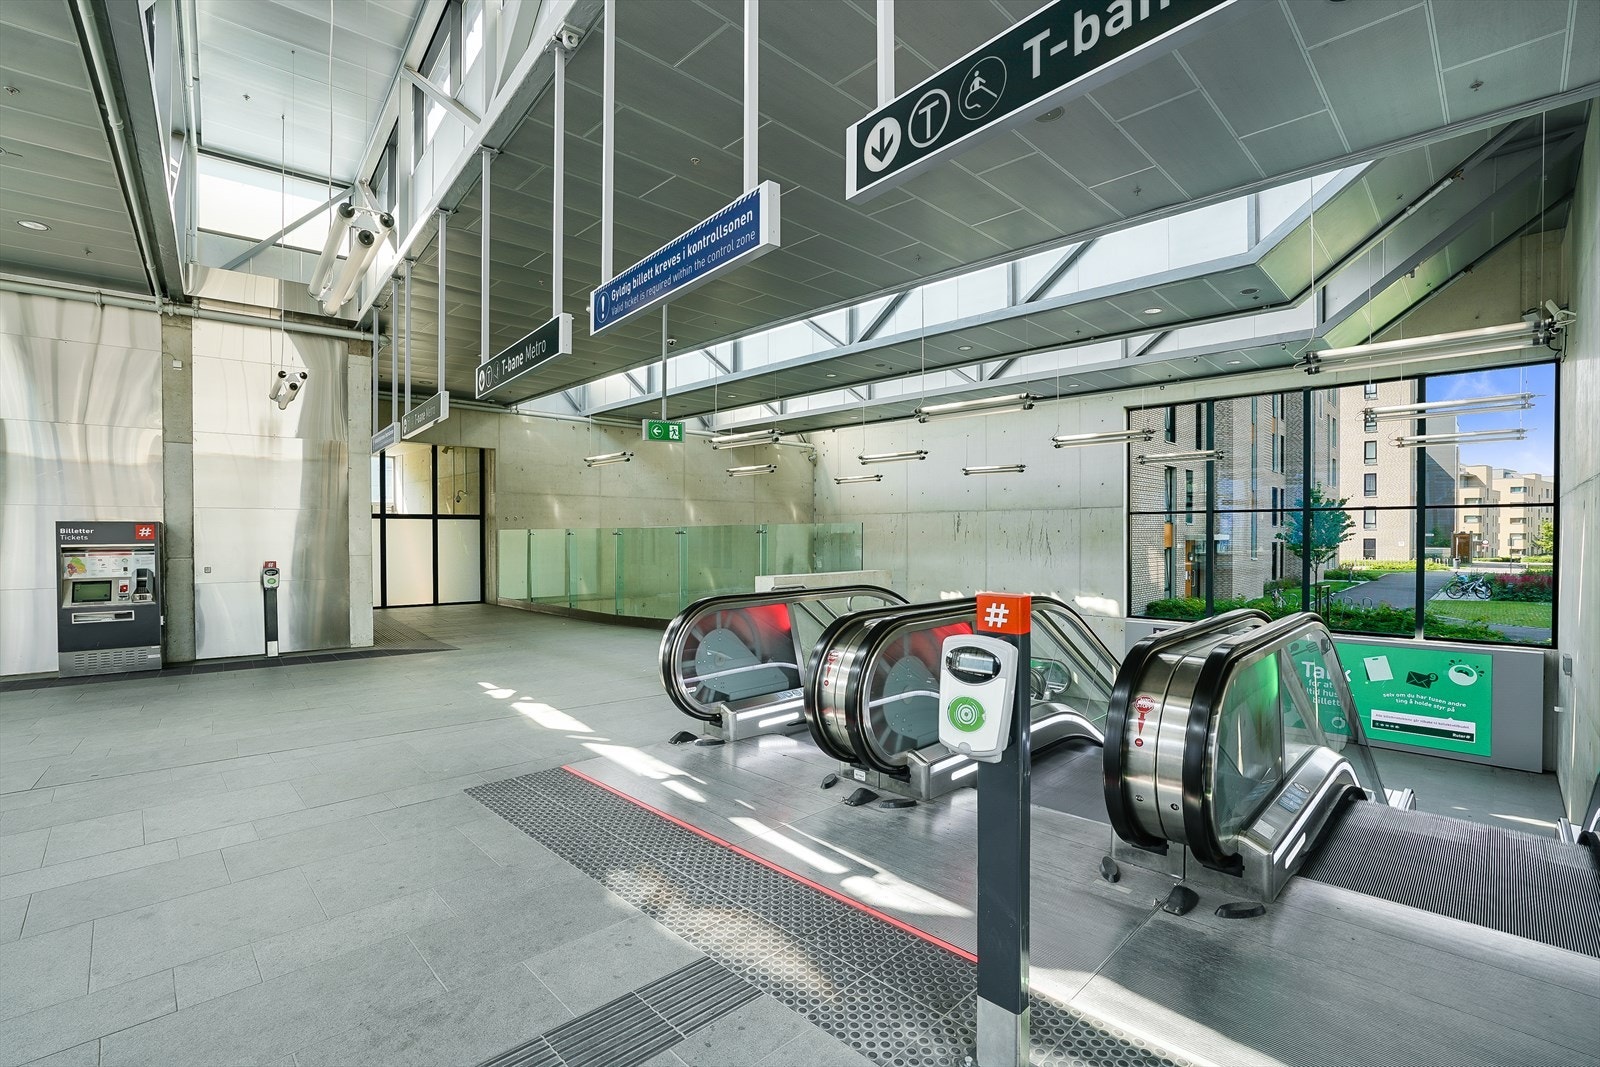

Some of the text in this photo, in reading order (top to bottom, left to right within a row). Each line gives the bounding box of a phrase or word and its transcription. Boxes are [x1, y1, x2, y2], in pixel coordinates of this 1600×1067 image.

[611, 282, 631, 302] Gyldig
[632, 267, 654, 289] billett
[654, 253, 681, 276] kreves
[687, 210, 753, 257] kontrollsonen
[611, 230, 756, 316] Valid ticket is required within the control zone
[501, 352, 524, 375] T-bane
[525, 339, 547, 362] Metro
[1414, 699, 1432, 707] holde
[1433, 703, 1446, 711] styr
[1428, 696, 1447, 704] tusen
